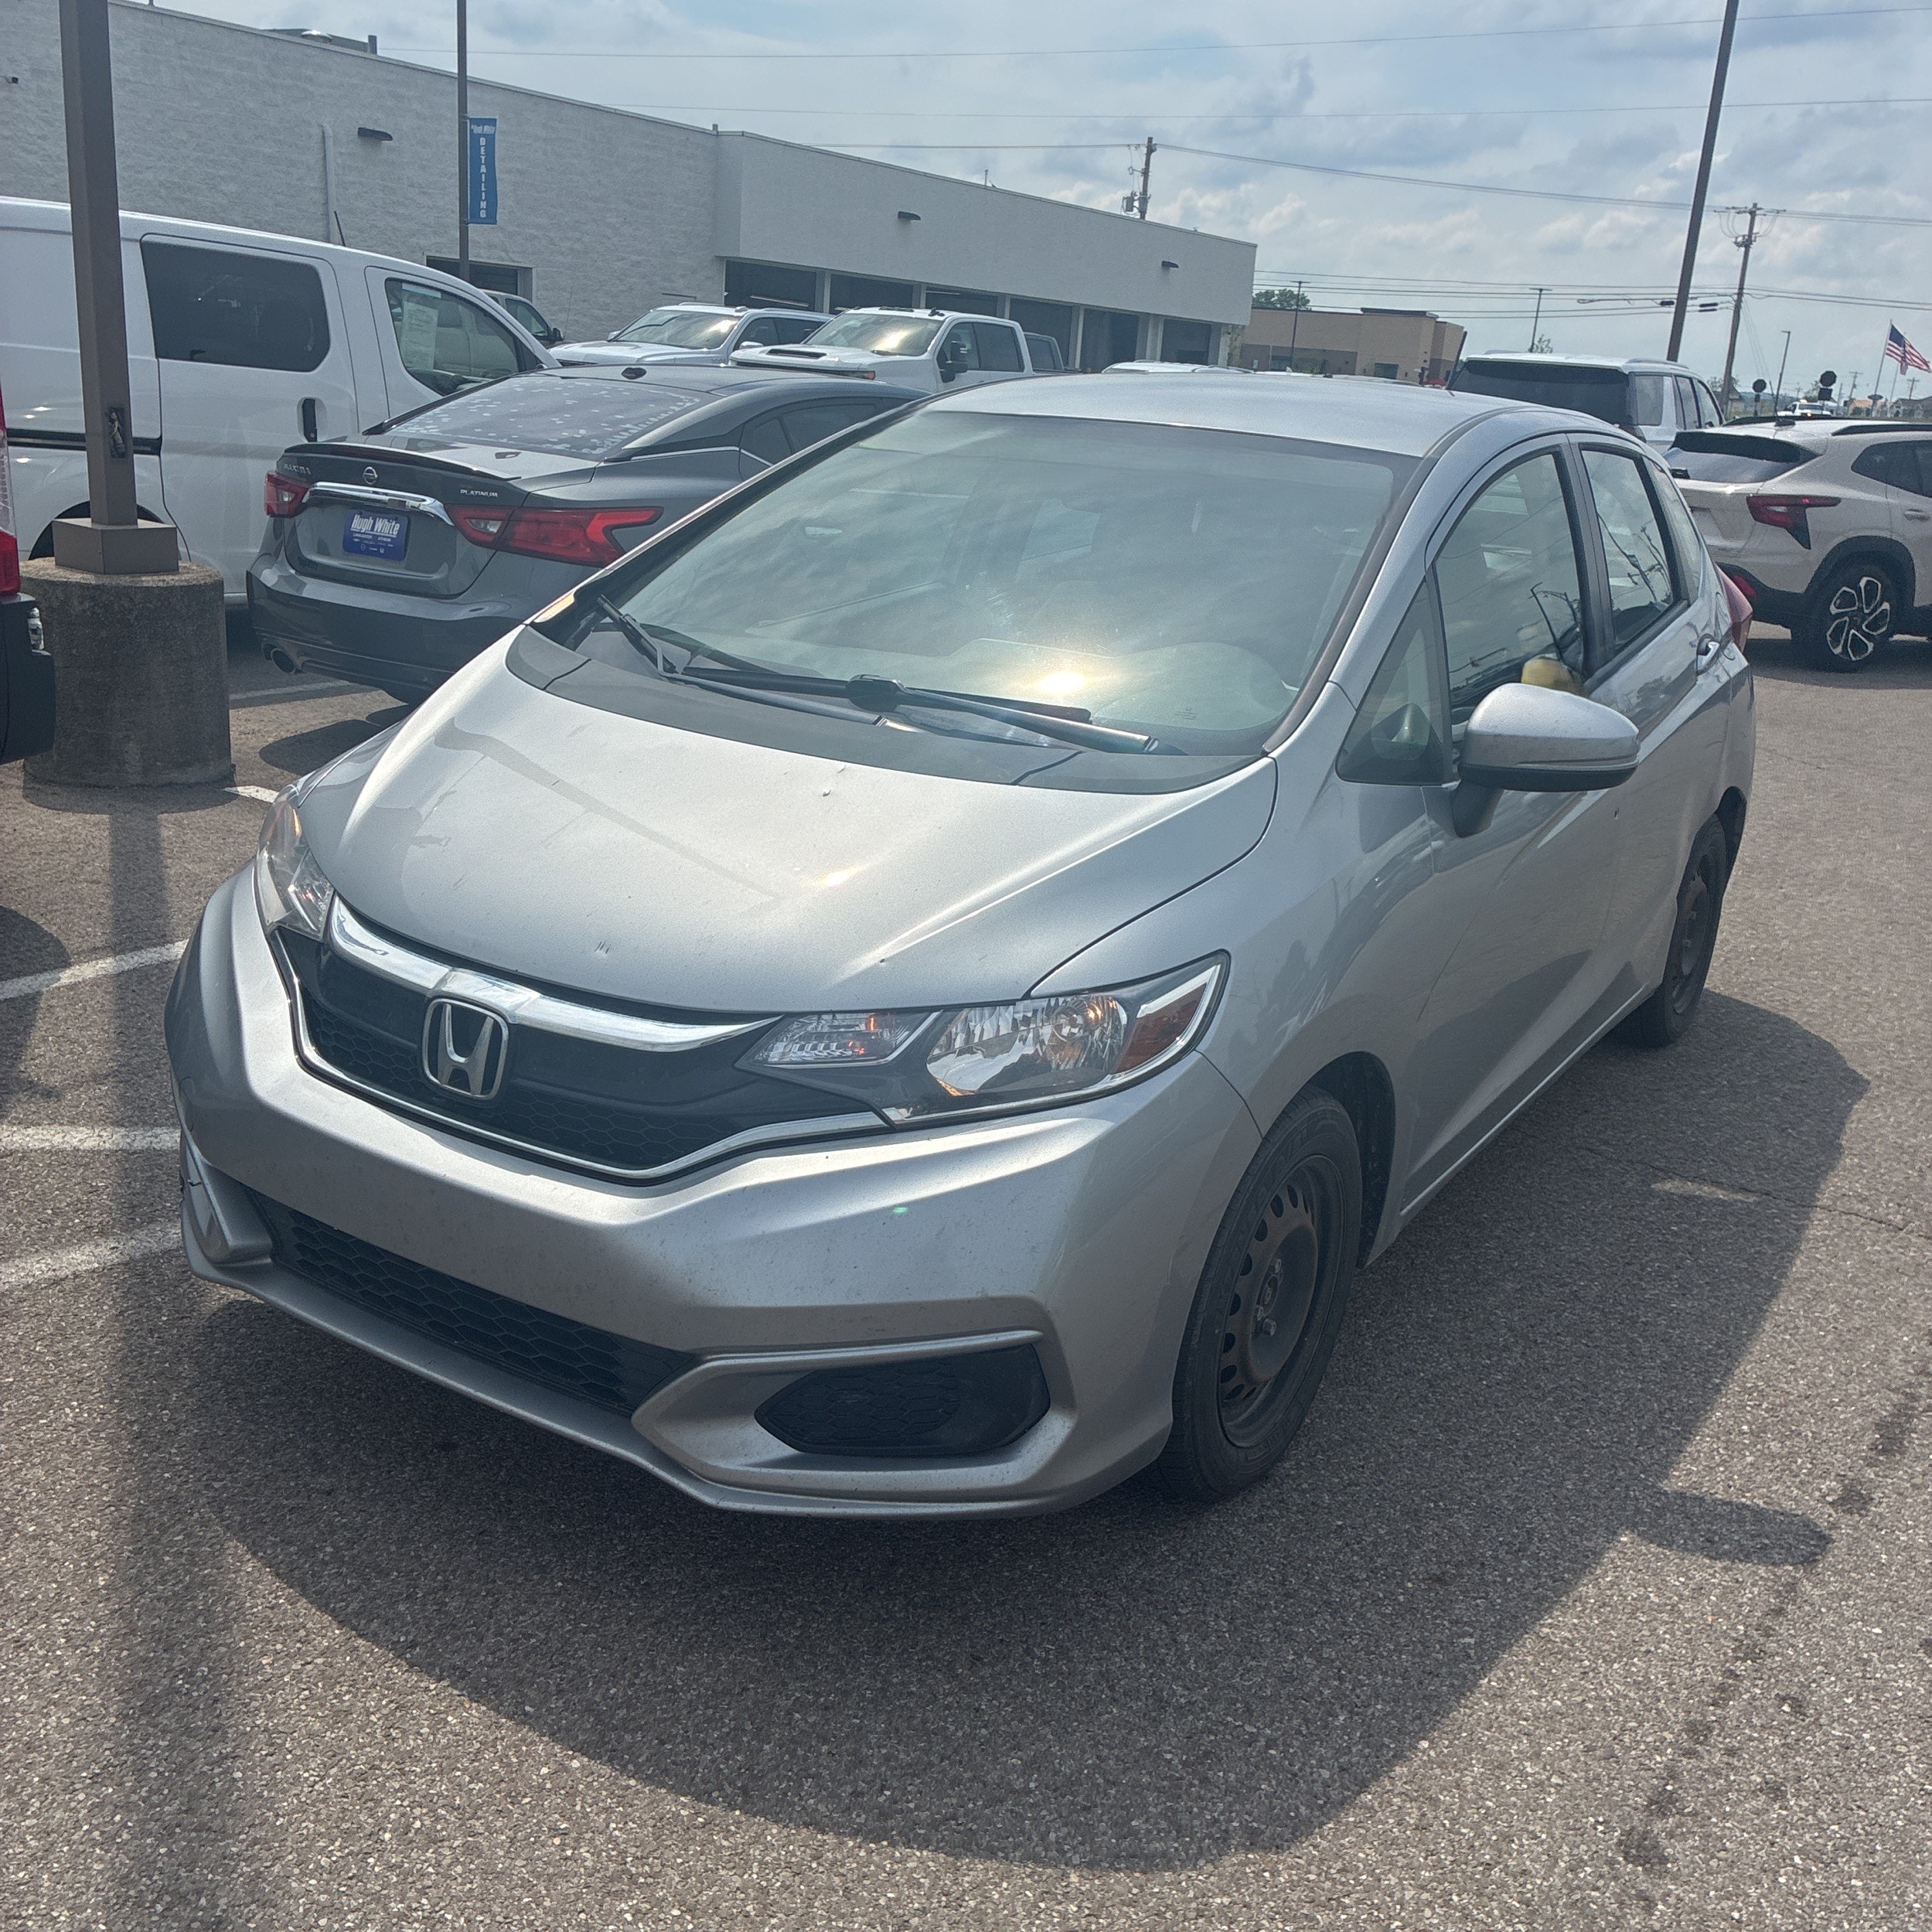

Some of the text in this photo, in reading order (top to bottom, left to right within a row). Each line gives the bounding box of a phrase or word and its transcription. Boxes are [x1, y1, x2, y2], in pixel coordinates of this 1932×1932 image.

[460, 489, 499, 497] PLATINUM
[351, 514, 400, 535] Hugh White
